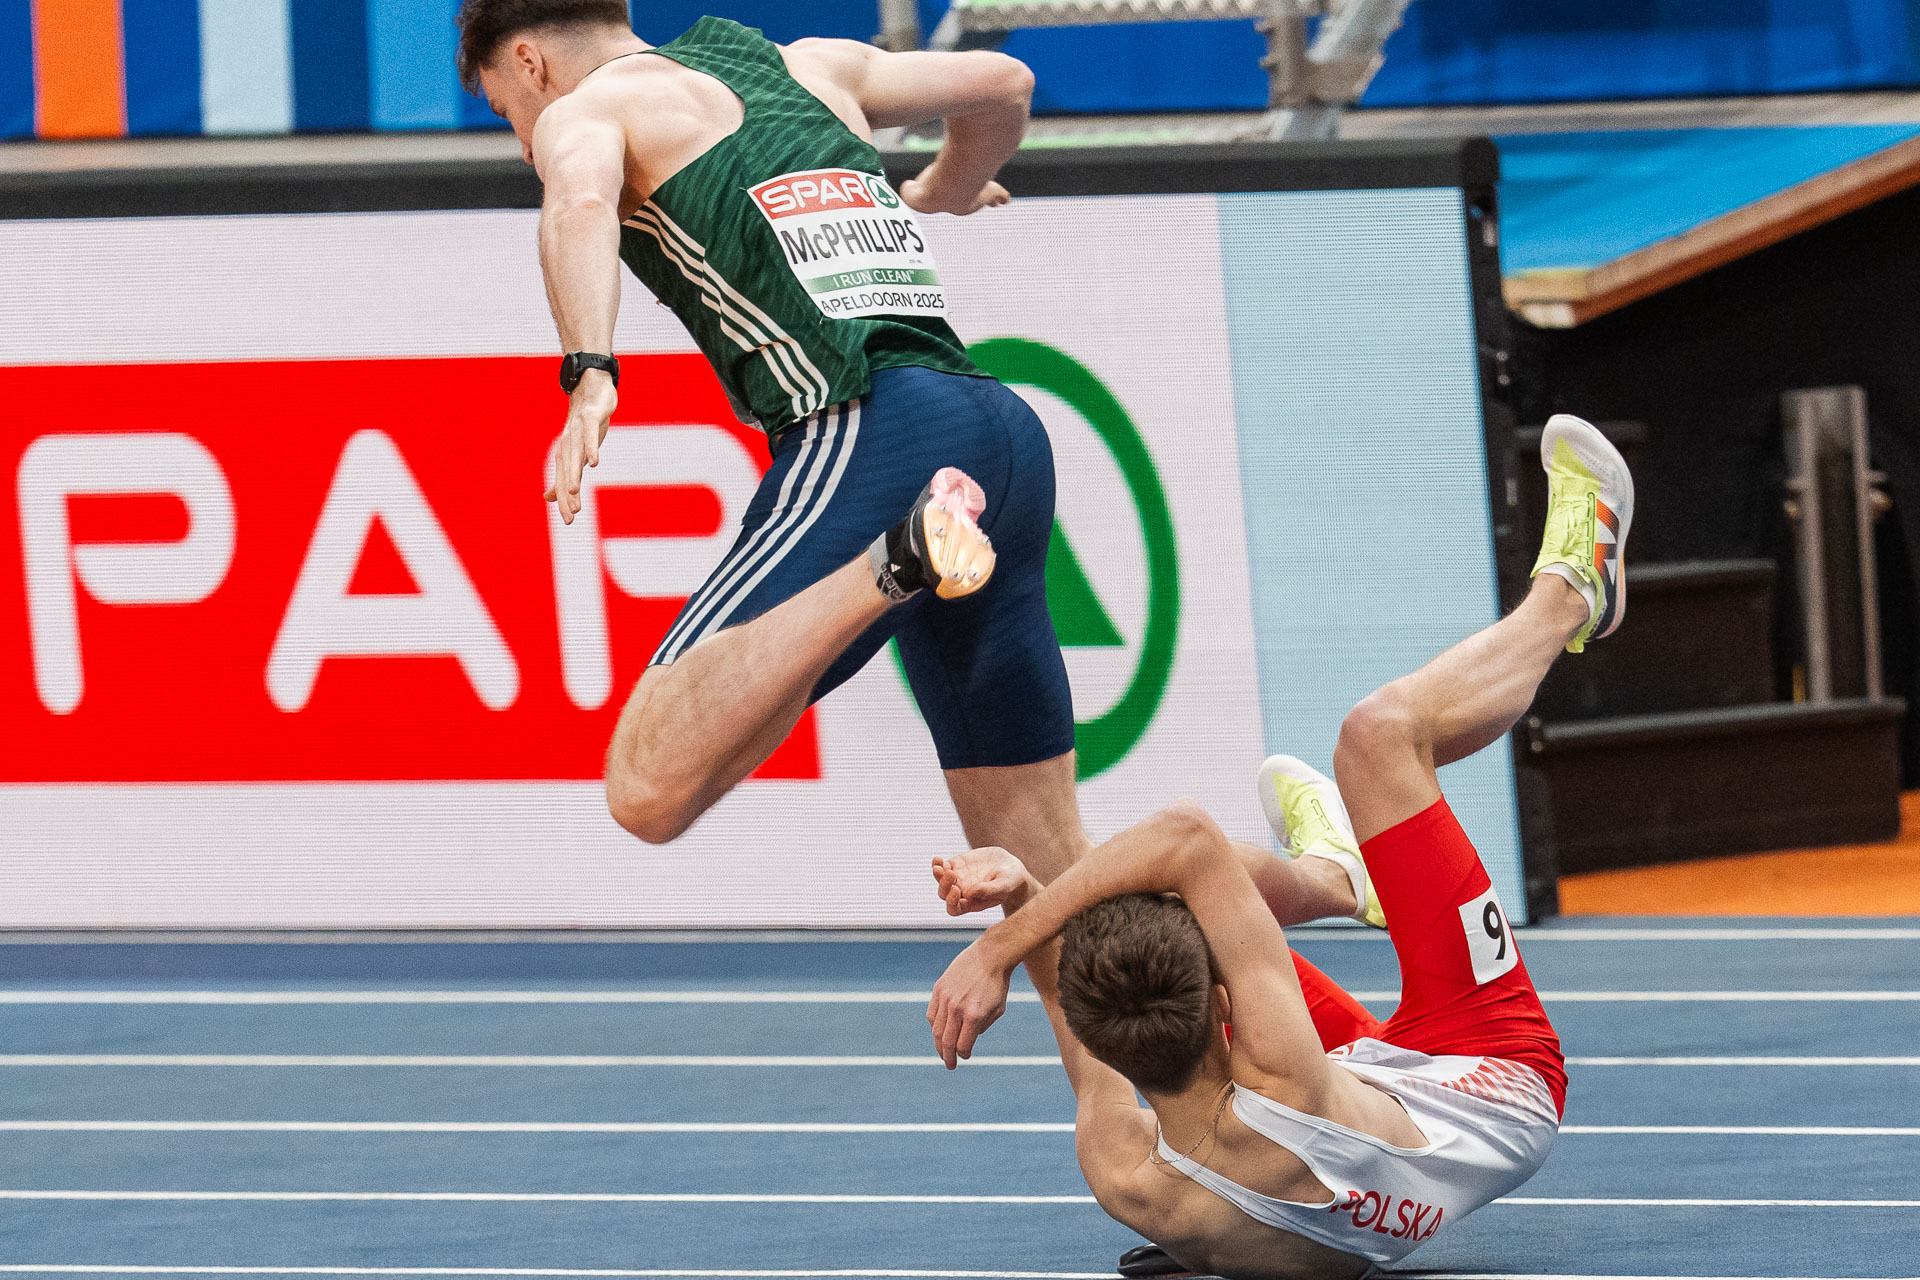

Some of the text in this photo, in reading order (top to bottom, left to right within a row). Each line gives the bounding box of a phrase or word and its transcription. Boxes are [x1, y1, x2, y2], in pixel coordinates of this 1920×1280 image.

[761, 177, 870, 213] SPAR
[781, 219, 924, 264] McPHILLIPS
[841, 271, 874, 287] RUN
[820, 292, 945, 313] APELDOORN 2025
[1482, 901, 1506, 960] 9
